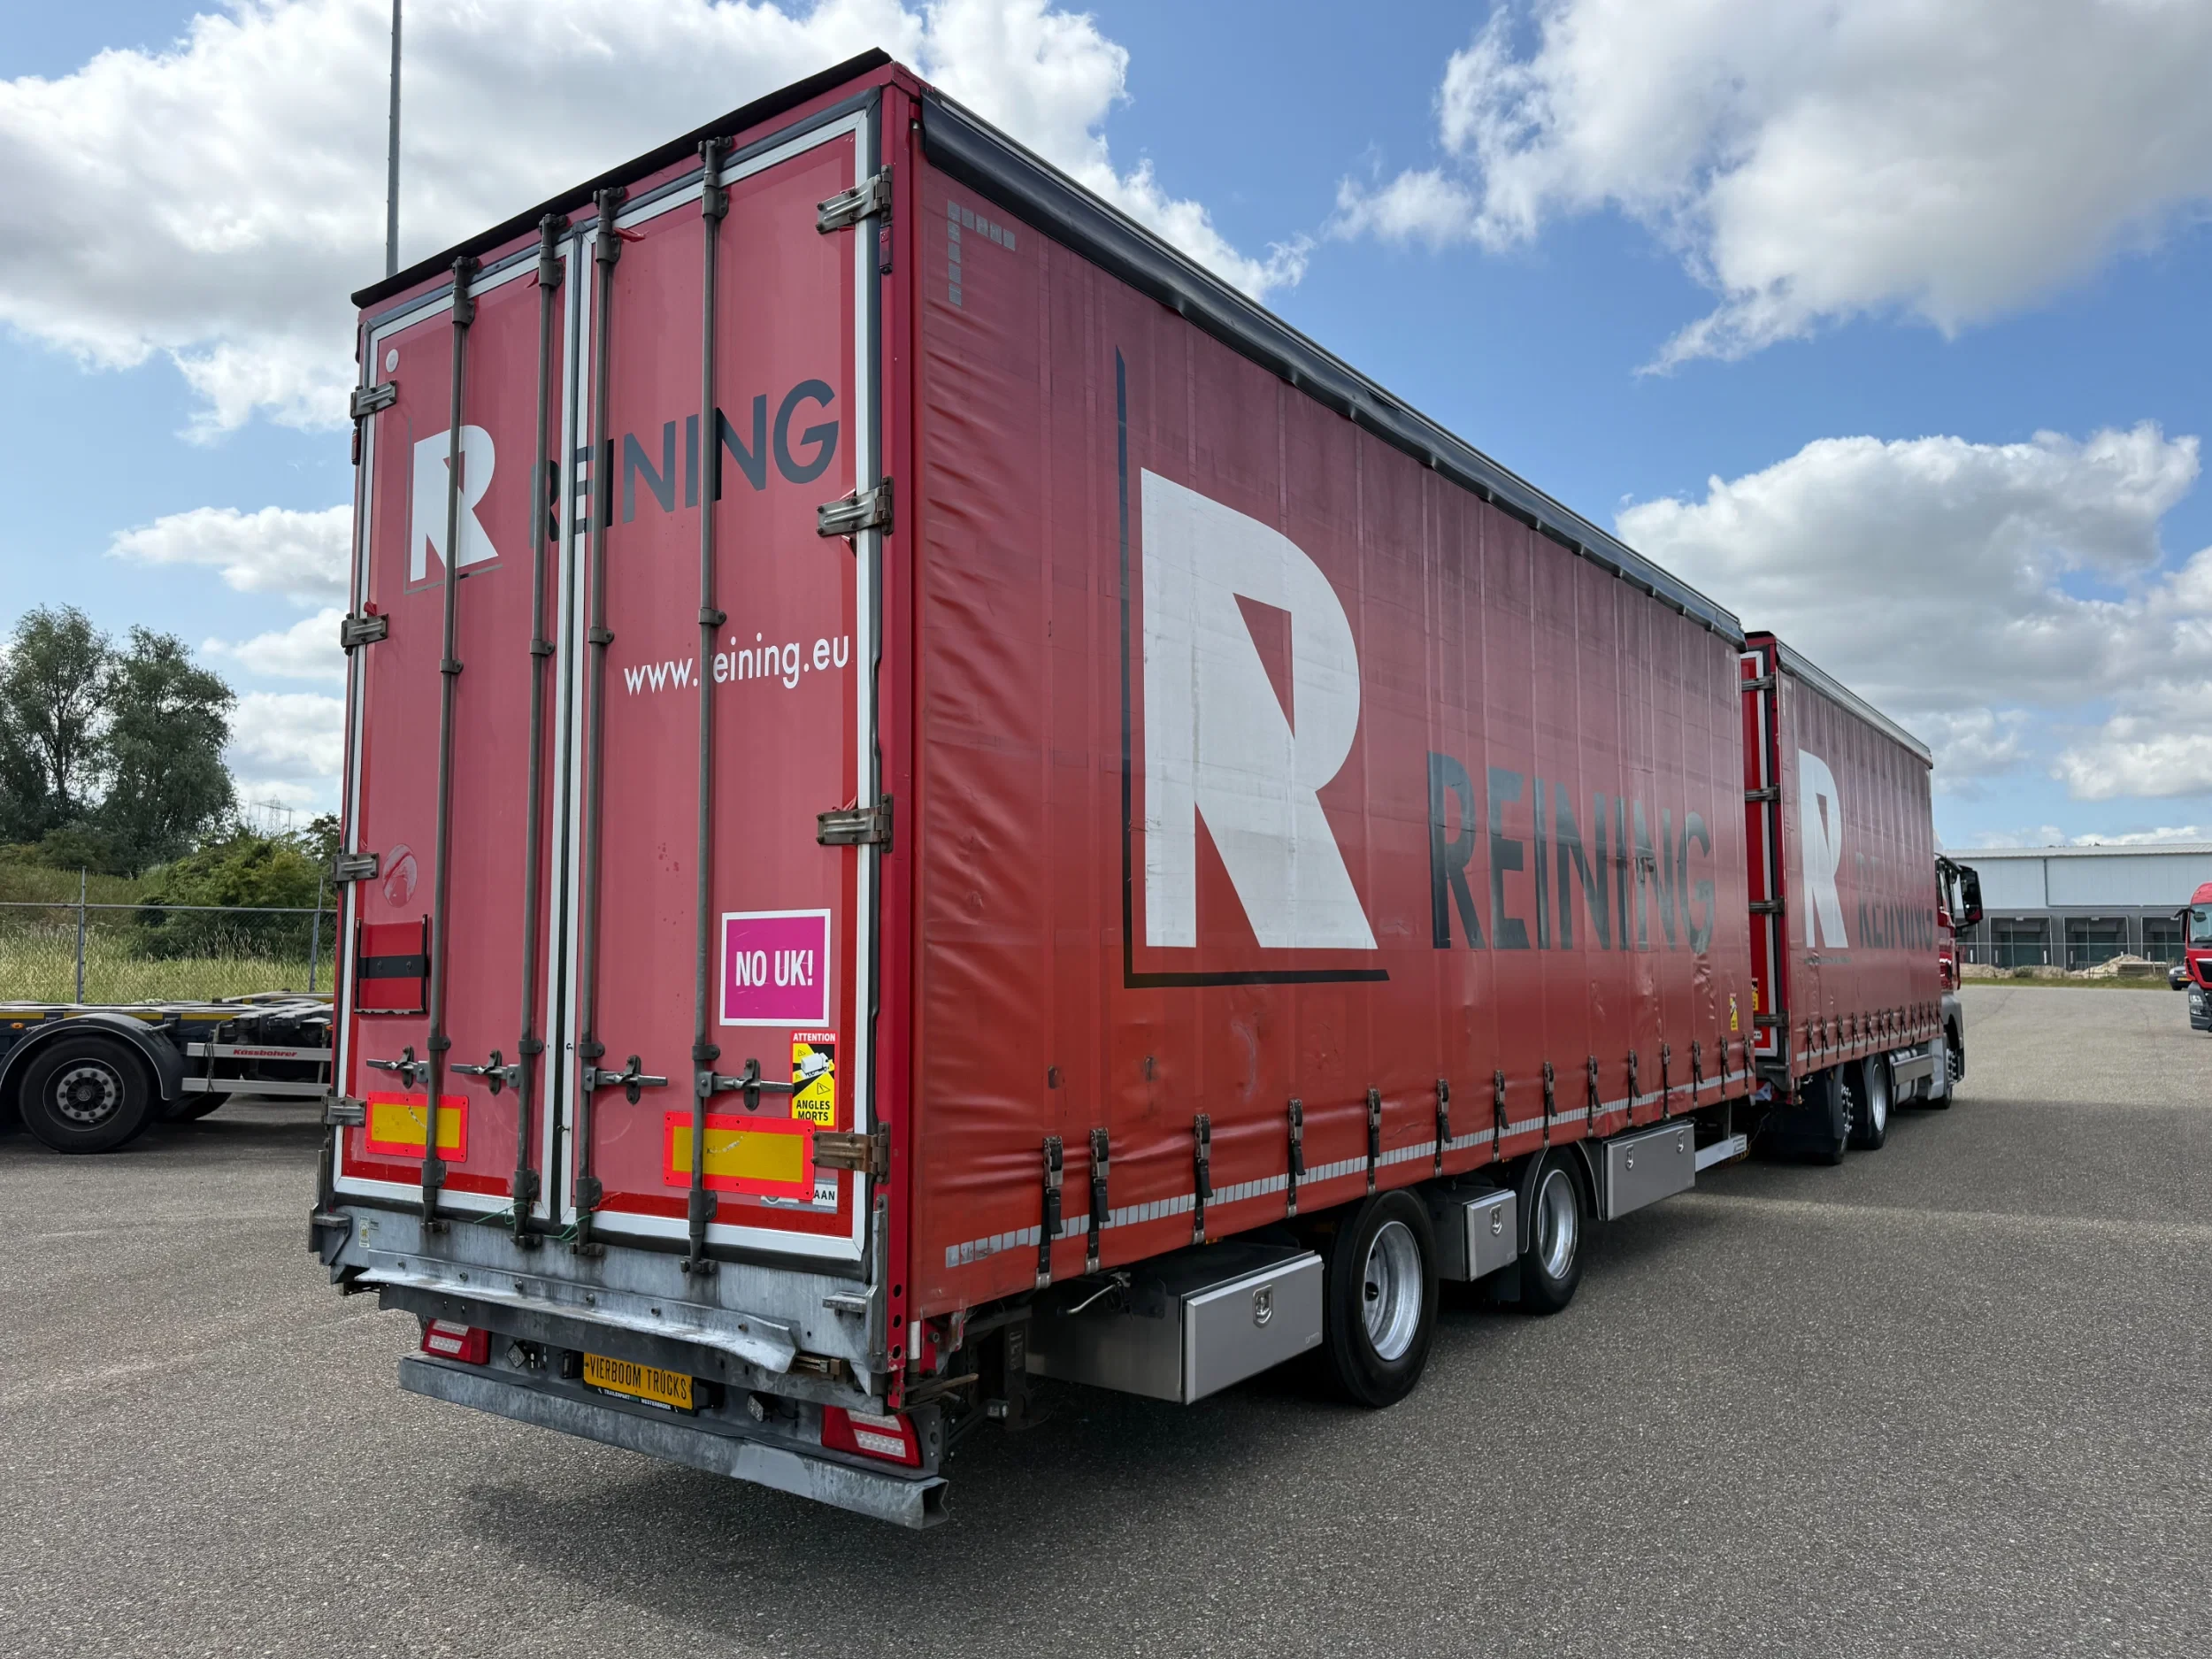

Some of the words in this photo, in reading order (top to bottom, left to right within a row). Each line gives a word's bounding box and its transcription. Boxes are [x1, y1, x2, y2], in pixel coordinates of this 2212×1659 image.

[410, 425, 498, 582] R
[529, 379, 840, 549] REINING
[624, 633, 849, 696] www.eining.eu
[1141, 467, 1378, 949] R
[1427, 750, 1715, 953] REINING
[1798, 748, 1848, 949] R
[735, 949, 767, 987] NO
[774, 949, 813, 987] UK!
[793, 1033, 836, 1042] ATTENTION
[796, 1100, 830, 1110] ANGLES
[798, 1110, 829, 1122] MORTS
[590, 1356, 641, 1388] VIERBOOM
[647, 1369, 687, 1400] TRUCKS
